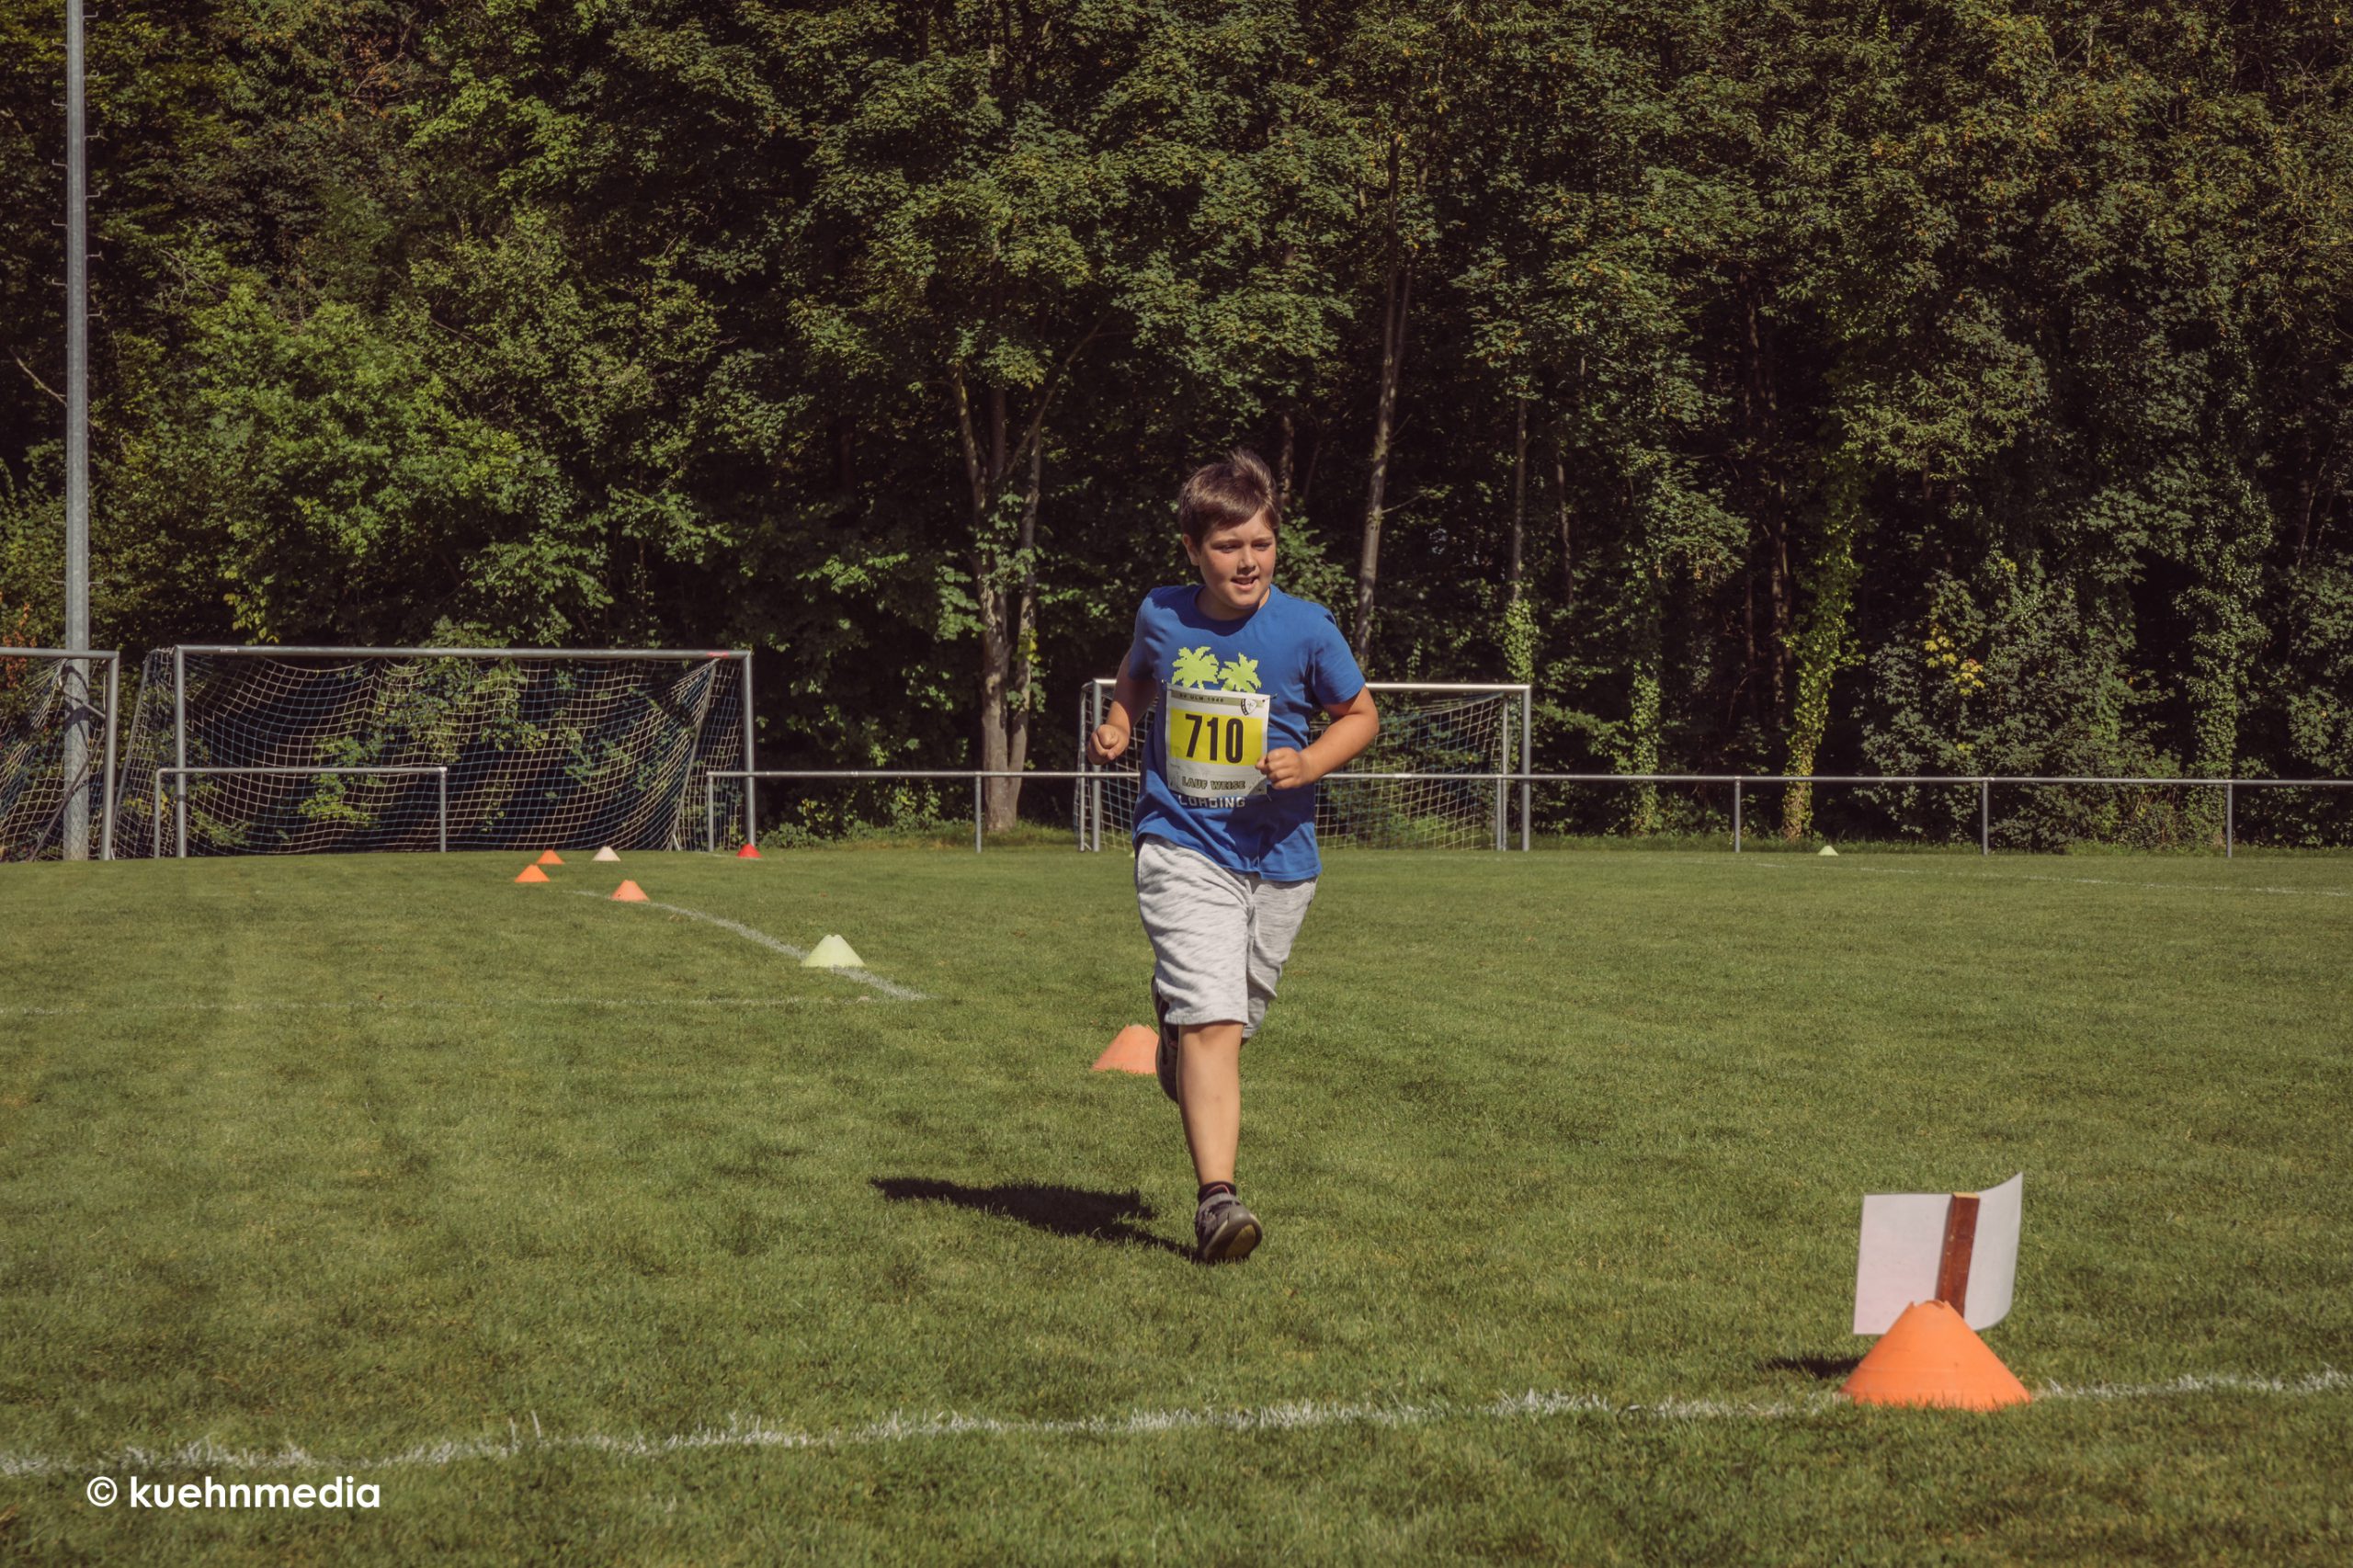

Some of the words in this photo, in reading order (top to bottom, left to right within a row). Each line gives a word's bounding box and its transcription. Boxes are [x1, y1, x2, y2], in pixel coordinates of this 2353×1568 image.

[1185, 713, 1244, 764] 710
[1182, 776, 1208, 790] LAUF
[1210, 779, 1245, 790] WEISE
